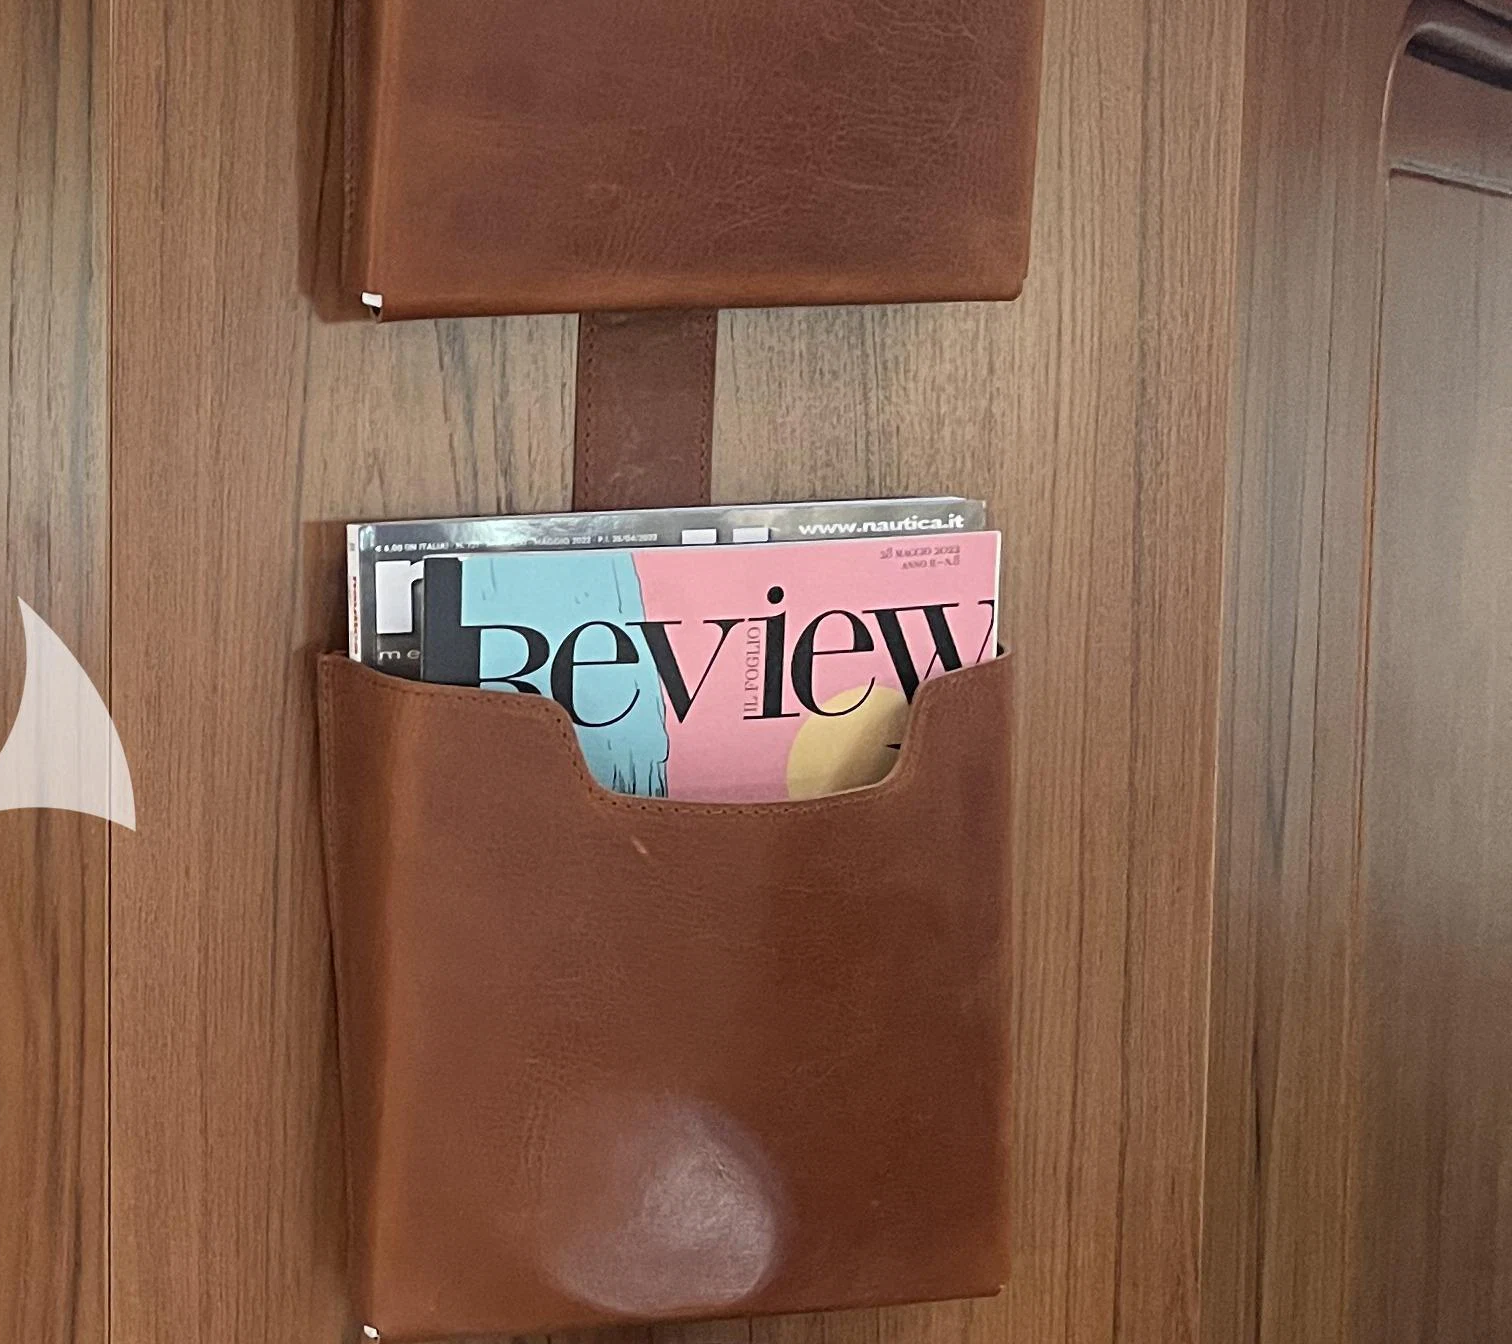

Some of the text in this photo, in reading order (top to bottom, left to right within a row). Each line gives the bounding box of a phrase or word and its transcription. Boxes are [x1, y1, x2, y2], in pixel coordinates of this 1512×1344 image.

[798, 513, 965, 535] www.nautica.it
[461, 585, 996, 727] Review
[744, 626, 760, 712] IL FOGLIO
